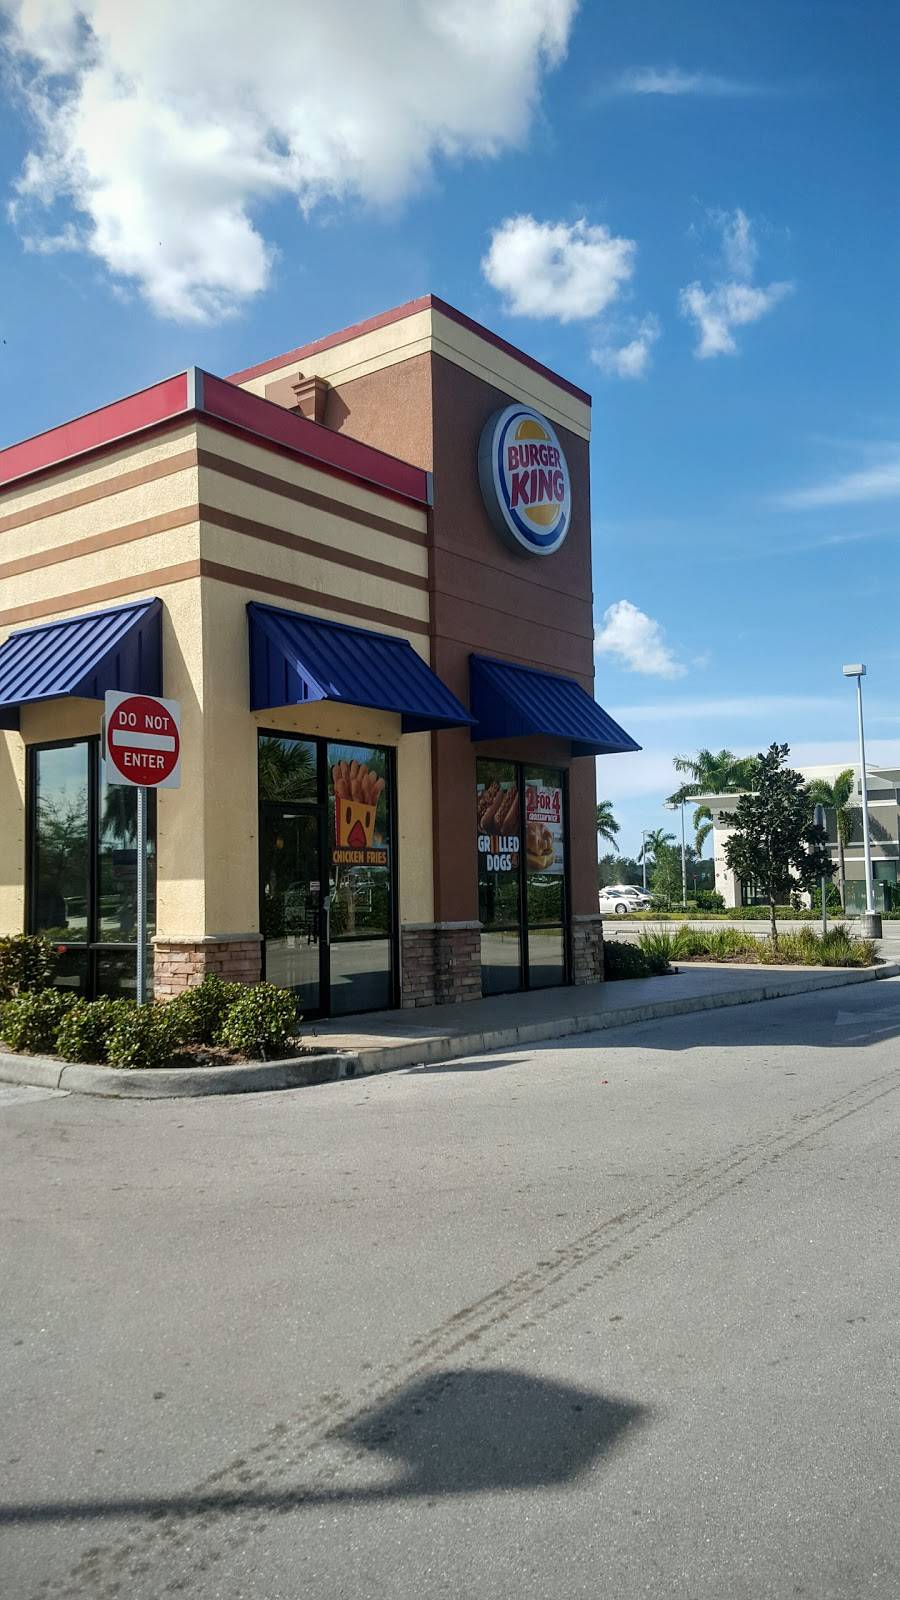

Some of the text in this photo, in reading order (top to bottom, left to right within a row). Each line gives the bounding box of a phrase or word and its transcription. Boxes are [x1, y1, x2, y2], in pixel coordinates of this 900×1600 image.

[508, 443, 562, 471] BURGER
[510, 469, 565, 508] KING
[119, 711, 170, 731] DO NOT
[124, 751, 165, 769] ENTER
[526, 786, 537, 812] 2
[536, 793, 551, 810] FOR
[478, 834, 520, 853] GRILLED
[332, 850, 387, 865] CHICKEN FRIES
[486, 853, 512, 872] DOGS
